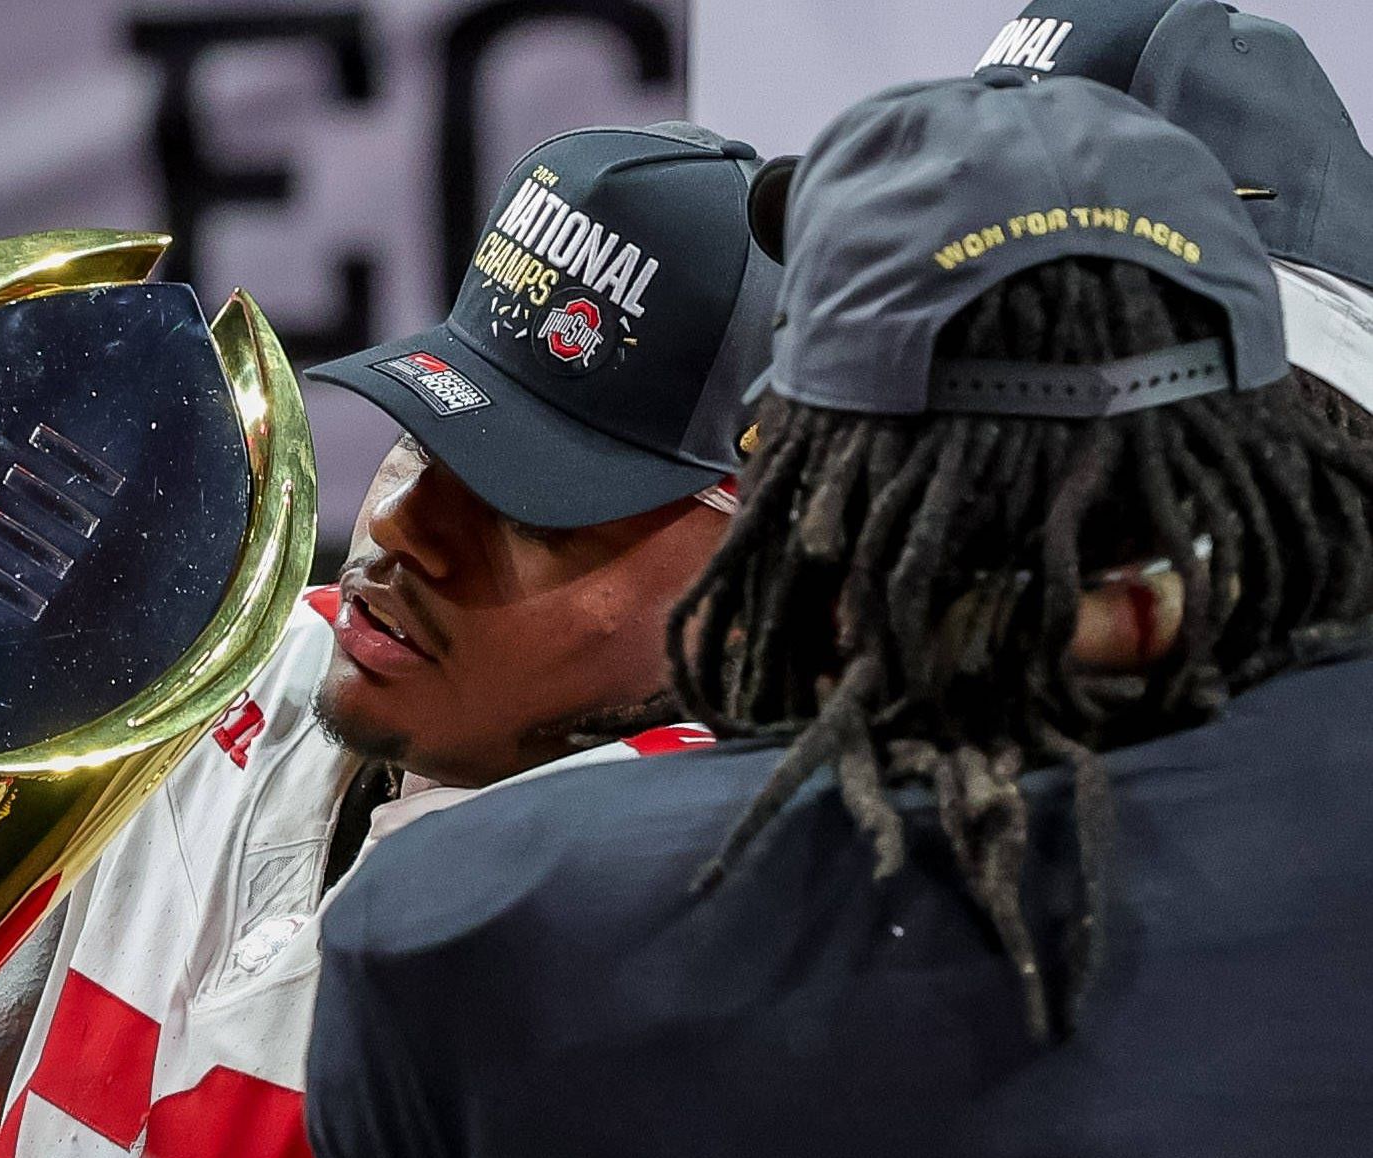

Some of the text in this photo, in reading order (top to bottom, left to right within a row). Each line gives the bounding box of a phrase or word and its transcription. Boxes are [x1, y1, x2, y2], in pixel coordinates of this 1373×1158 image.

[532, 164, 560, 188] 2024
[473, 230, 560, 307] CHAMPS
[496, 177, 659, 319] NATIONAL
[934, 224, 1005, 271] WON
[1008, 207, 1070, 239] FOR
[1070, 207, 1131, 234] THE
